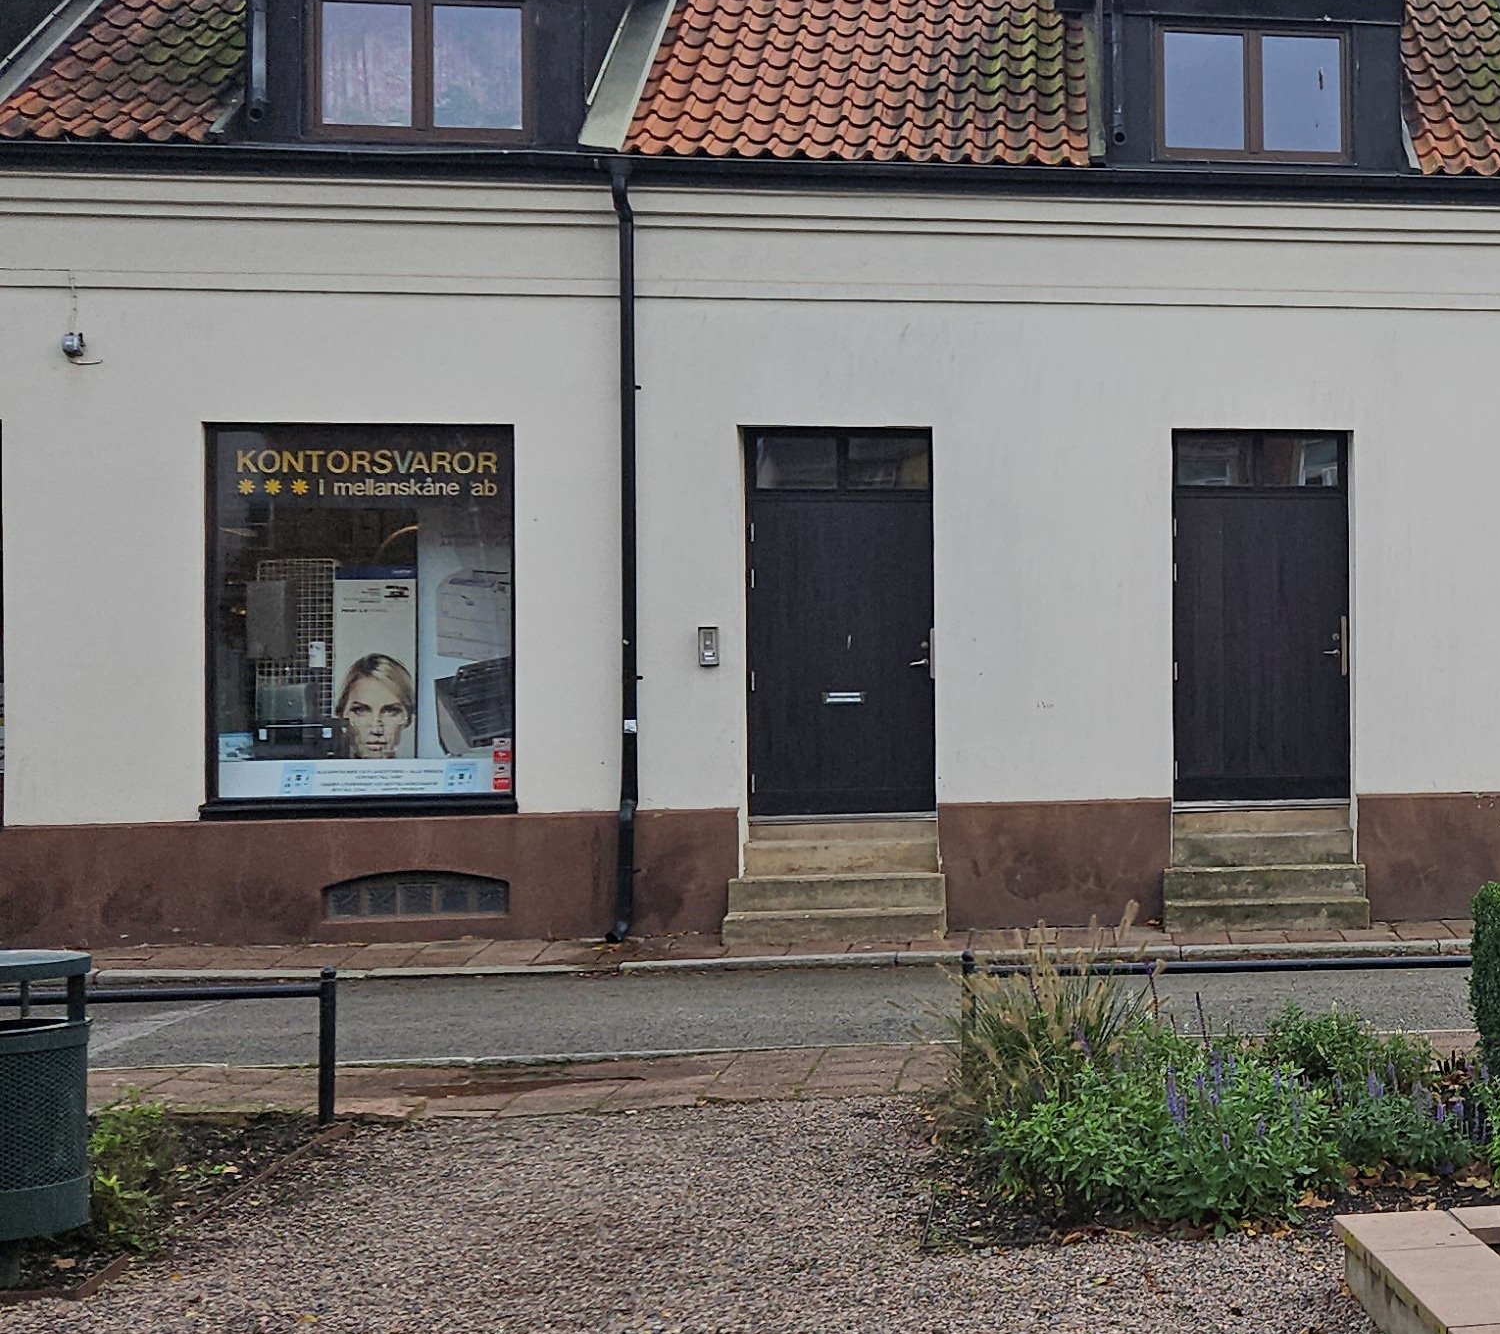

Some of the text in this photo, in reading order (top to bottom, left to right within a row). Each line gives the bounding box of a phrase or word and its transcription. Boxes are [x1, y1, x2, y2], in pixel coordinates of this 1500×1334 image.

[236, 450, 498, 474] KONTORSVAROR
[333, 477, 461, 497] mellanskåne
[470, 479, 498, 496] ab
